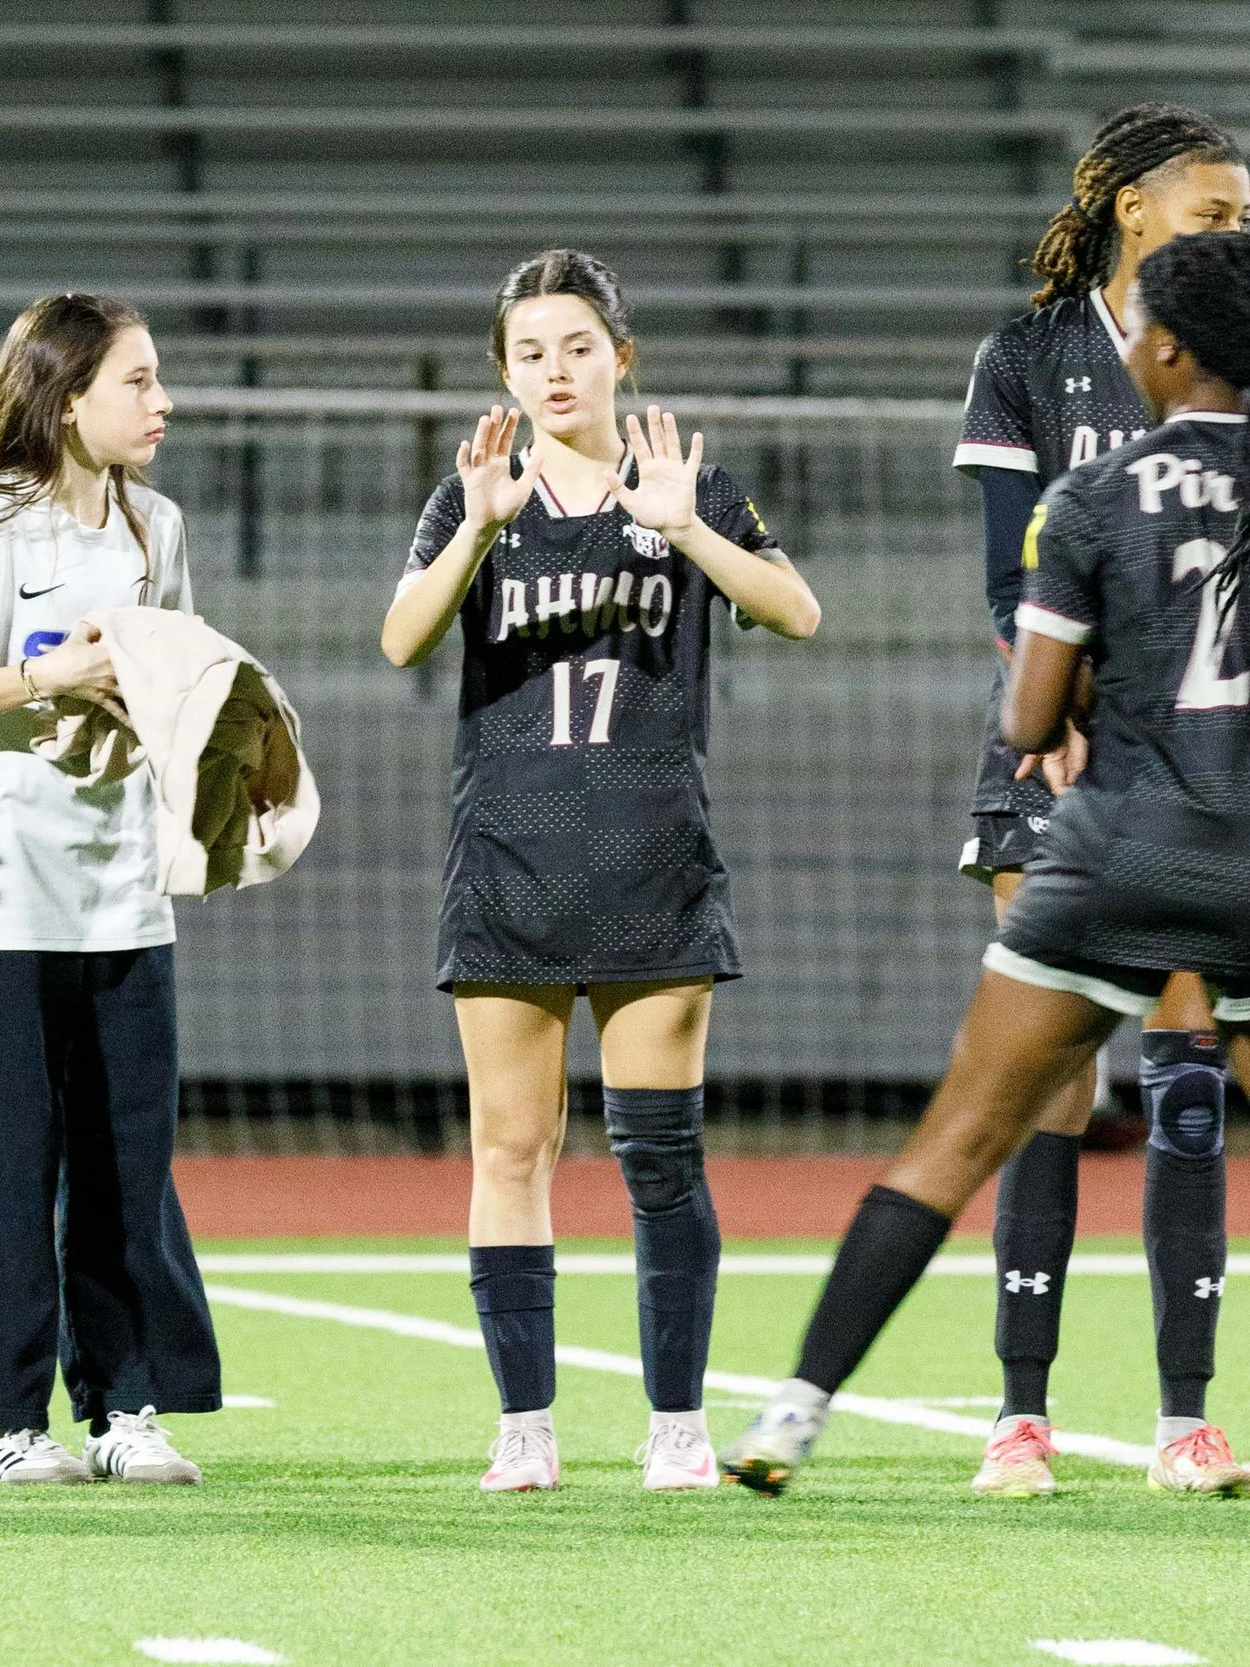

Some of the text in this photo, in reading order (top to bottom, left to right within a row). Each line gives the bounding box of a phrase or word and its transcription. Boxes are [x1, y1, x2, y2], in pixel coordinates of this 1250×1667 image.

[497, 570, 673, 642] AHMO
[1172, 538, 1250, 709] 2
[549, 658, 621, 745] 17
